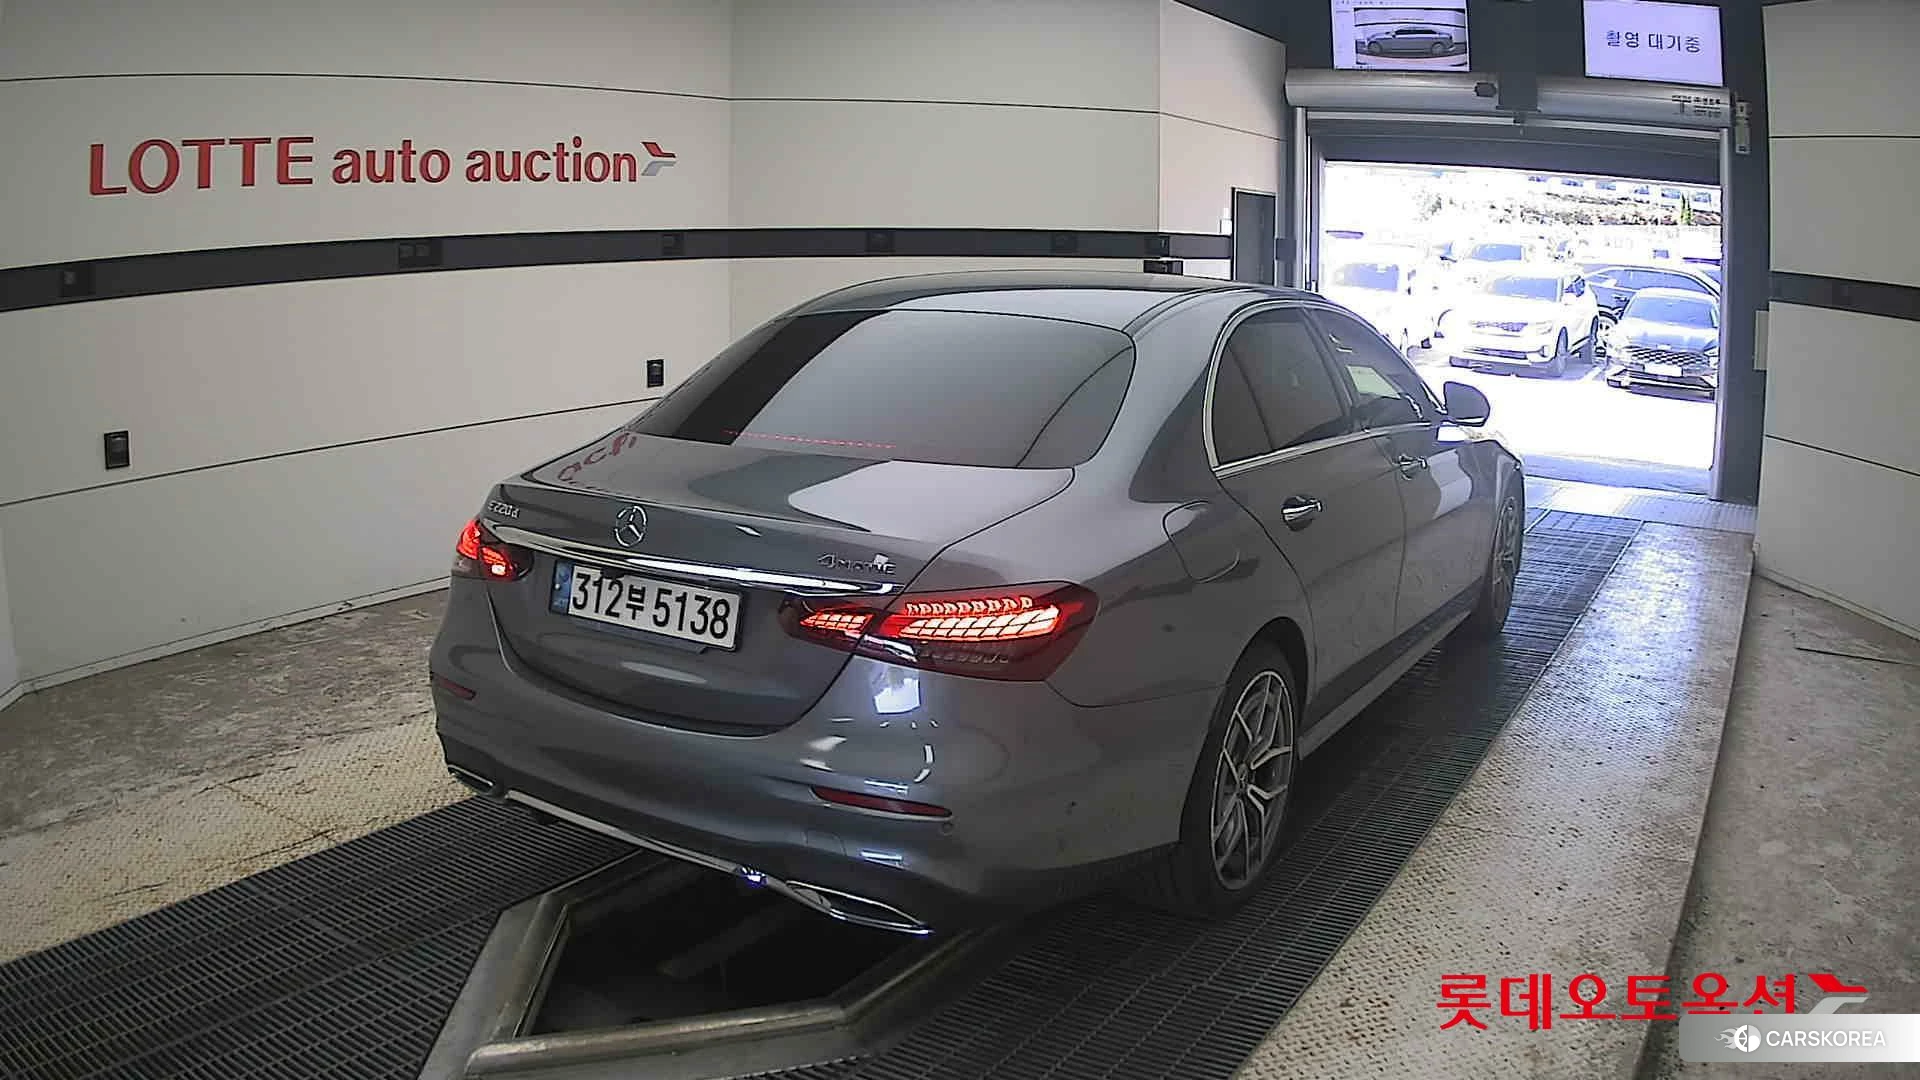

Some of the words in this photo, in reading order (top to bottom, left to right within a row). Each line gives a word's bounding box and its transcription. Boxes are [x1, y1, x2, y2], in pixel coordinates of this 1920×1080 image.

[89, 136, 314, 196] LOTTE
[332, 139, 450, 184] auto
[464, 136, 638, 183] auction
